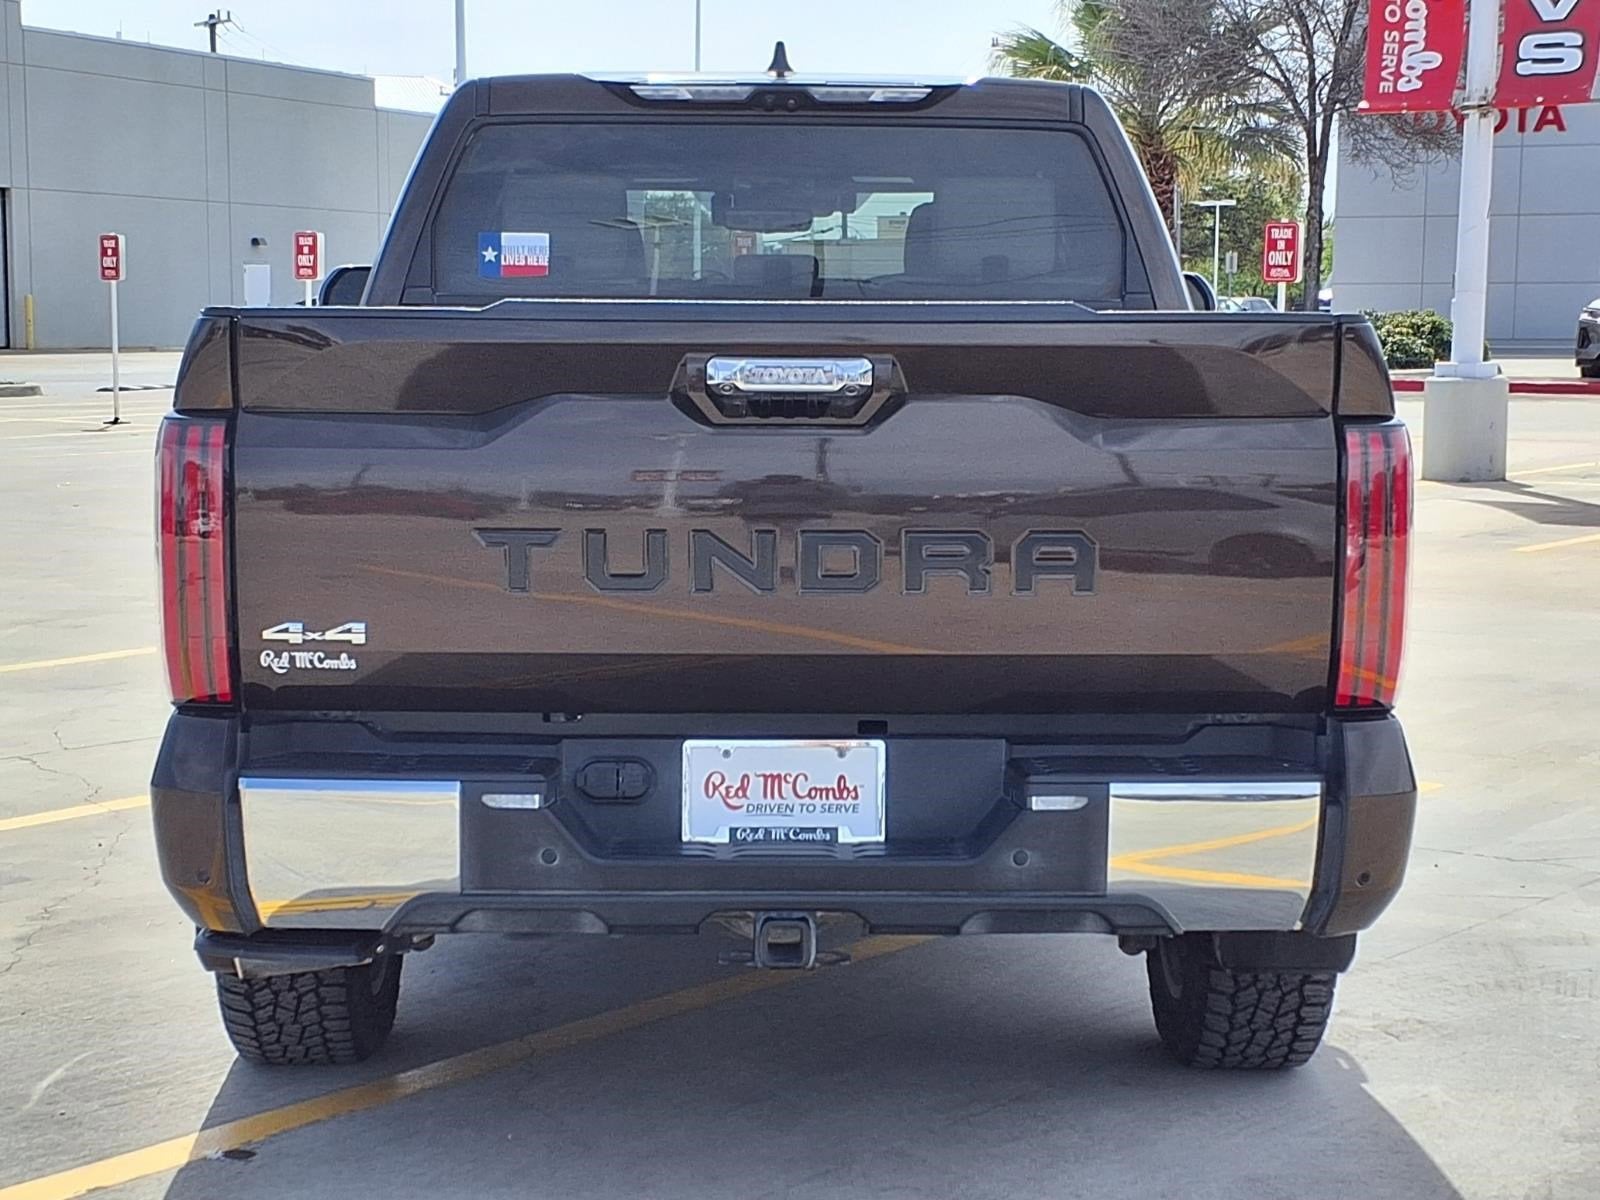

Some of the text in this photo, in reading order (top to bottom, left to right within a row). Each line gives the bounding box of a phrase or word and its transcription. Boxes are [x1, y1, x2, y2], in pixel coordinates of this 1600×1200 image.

[1379, 0, 1400, 93] O SERVE
[1271, 228, 1294, 239] TRADE
[501, 255, 549, 266] LIVES HERE
[1268, 251, 1294, 266] ONLY
[750, 367, 828, 384] TOYOTA
[473, 527, 1098, 596] TUNDRA
[261, 622, 366, 645] 4x4
[260, 650, 357, 674] Red McCombs
[704, 771, 860, 811] Red McCombs
[745, 803, 860, 815] DRIVEN TO SERVE
[736, 826, 831, 842] Red McCombs
